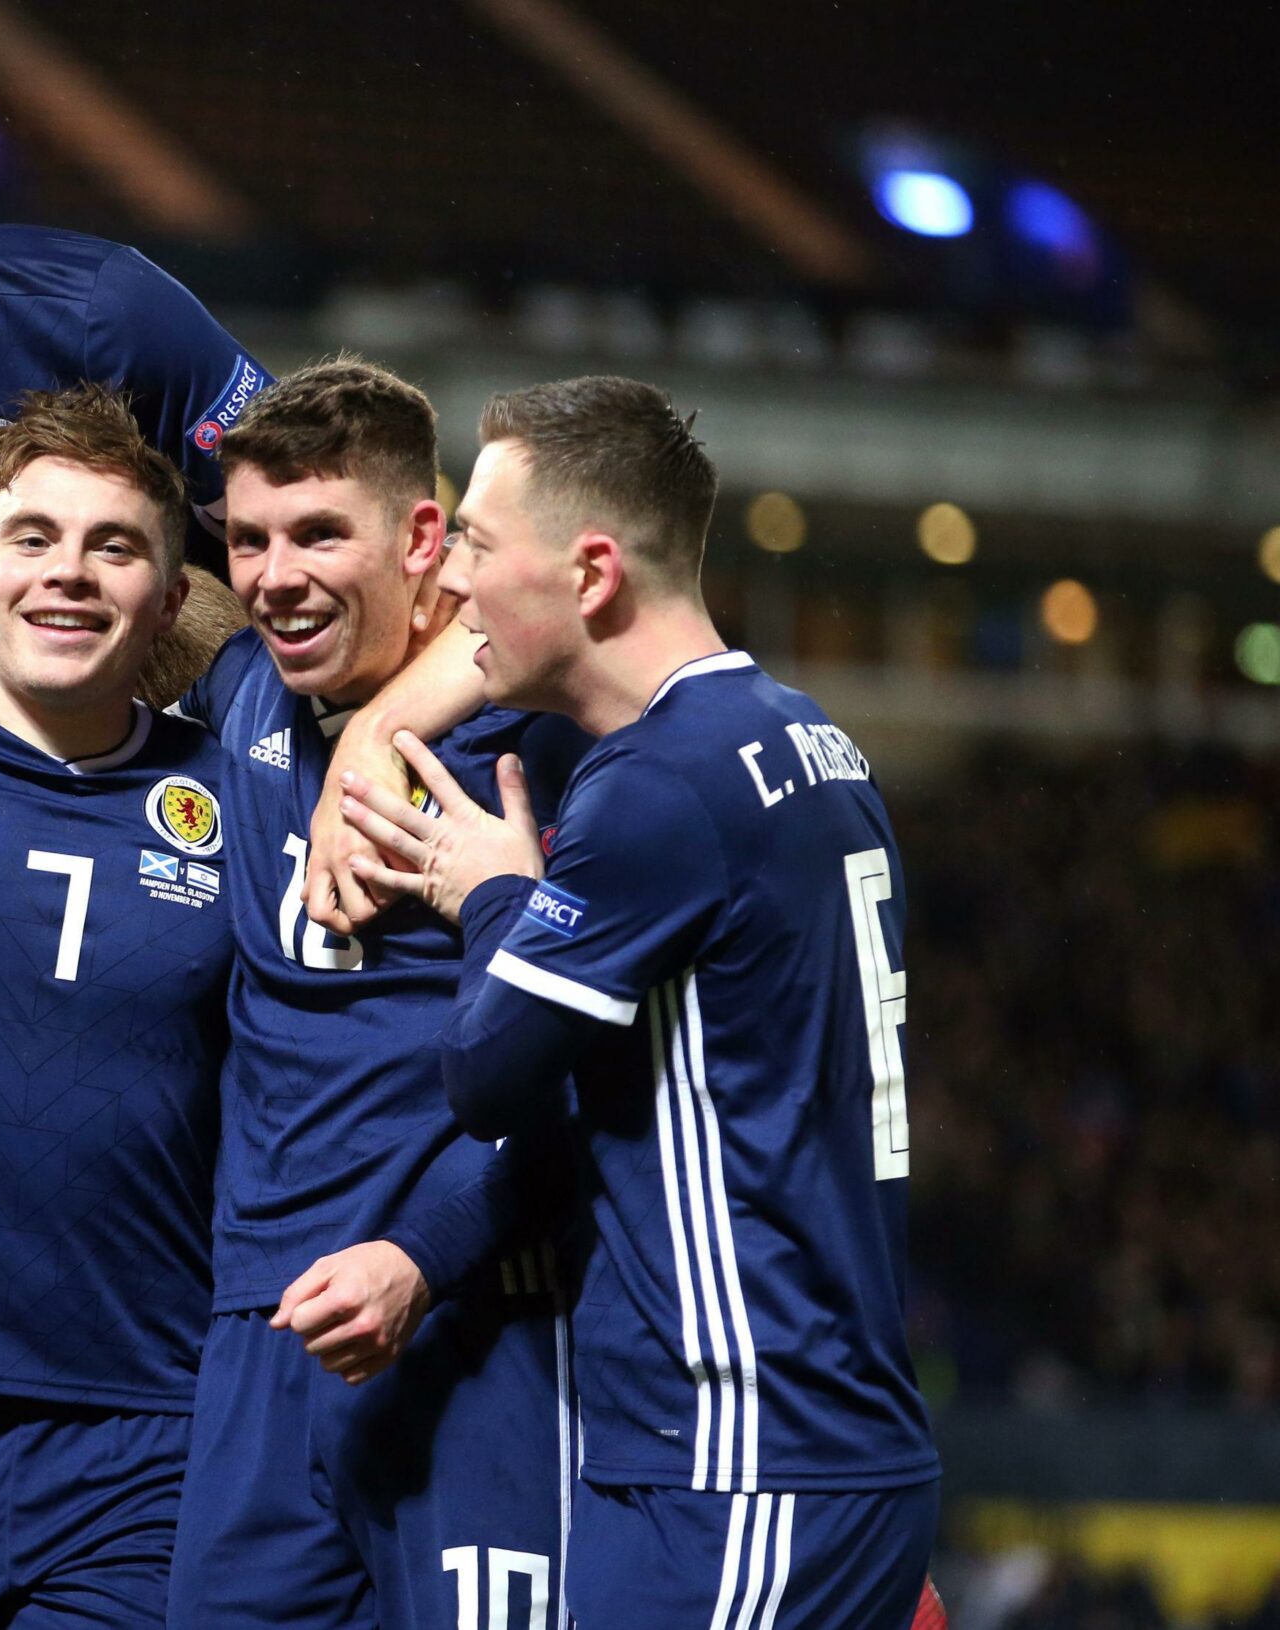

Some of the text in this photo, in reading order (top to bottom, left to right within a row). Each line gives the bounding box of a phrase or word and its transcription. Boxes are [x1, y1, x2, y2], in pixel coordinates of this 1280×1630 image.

[217, 361, 257, 427] RESPECT
[249, 744, 290, 771] adida
[737, 740, 795, 808] C.
[171, 779, 208, 797] SCOTLAND
[139, 877, 170, 891] HAMPDEN
[187, 888, 215, 903] GLASGOW
[149, 889, 159, 898] 20
[159, 891, 190, 905] NOVEMBER
[279, 832, 364, 971] 1
[529, 889, 583, 927] ESPECT
[26, 849, 94, 982] 7
